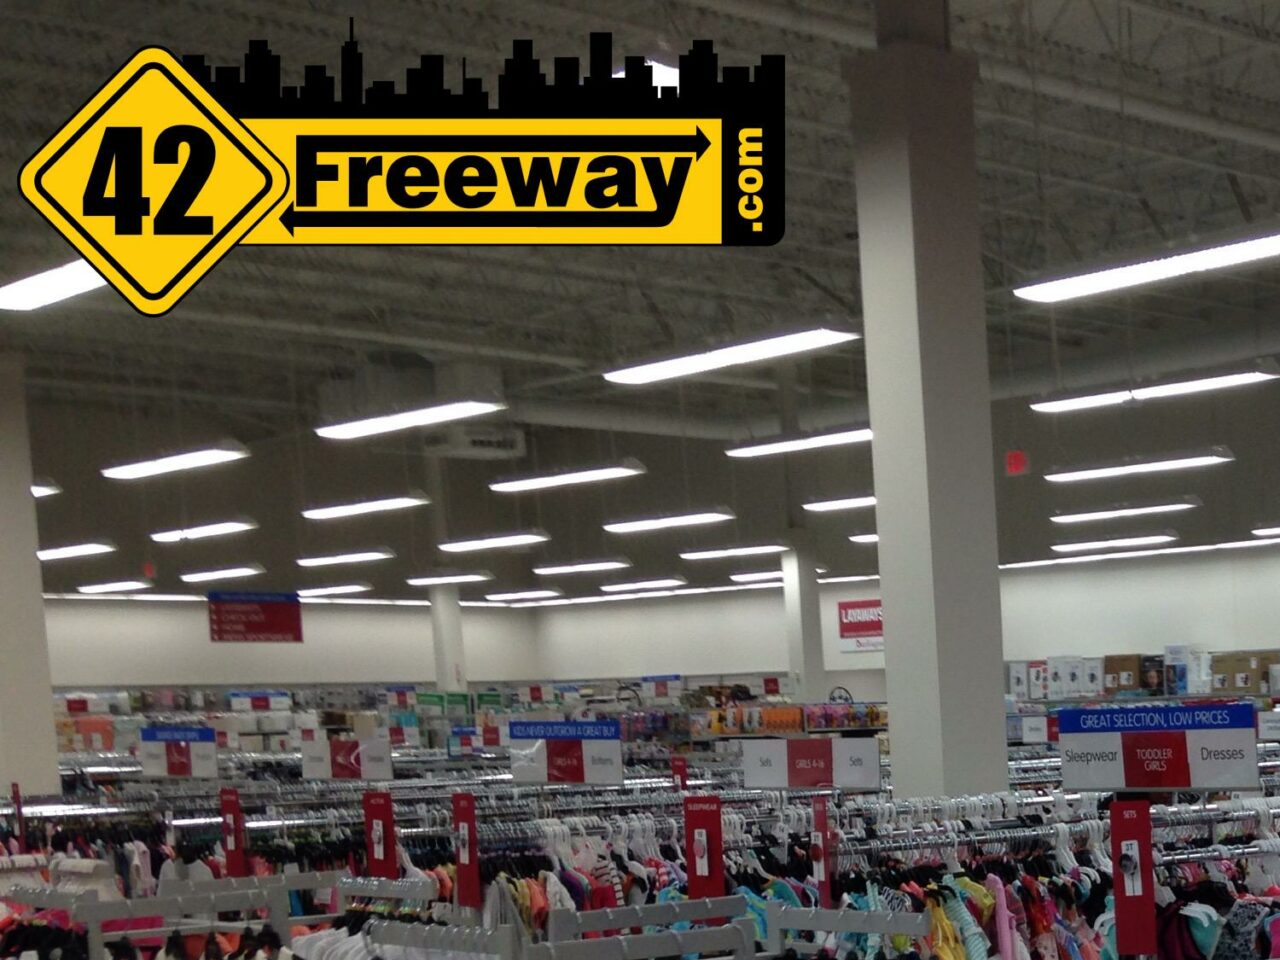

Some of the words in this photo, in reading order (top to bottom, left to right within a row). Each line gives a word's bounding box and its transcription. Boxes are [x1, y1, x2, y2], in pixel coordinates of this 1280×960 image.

[1080, 714, 1111, 729] GREAT
[1114, 712, 1167, 728] SELECTION,
[1169, 711, 1192, 726] LOW
[1195, 710, 1230, 725] PRICES
[1065, 750, 1118, 765] Sleepwear
[1136, 748, 1173, 760] TODDLER
[1201, 747, 1245, 761] Dresses
[1144, 760, 1167, 772] GIRLS
[1123, 809, 1137, 819] SETS
